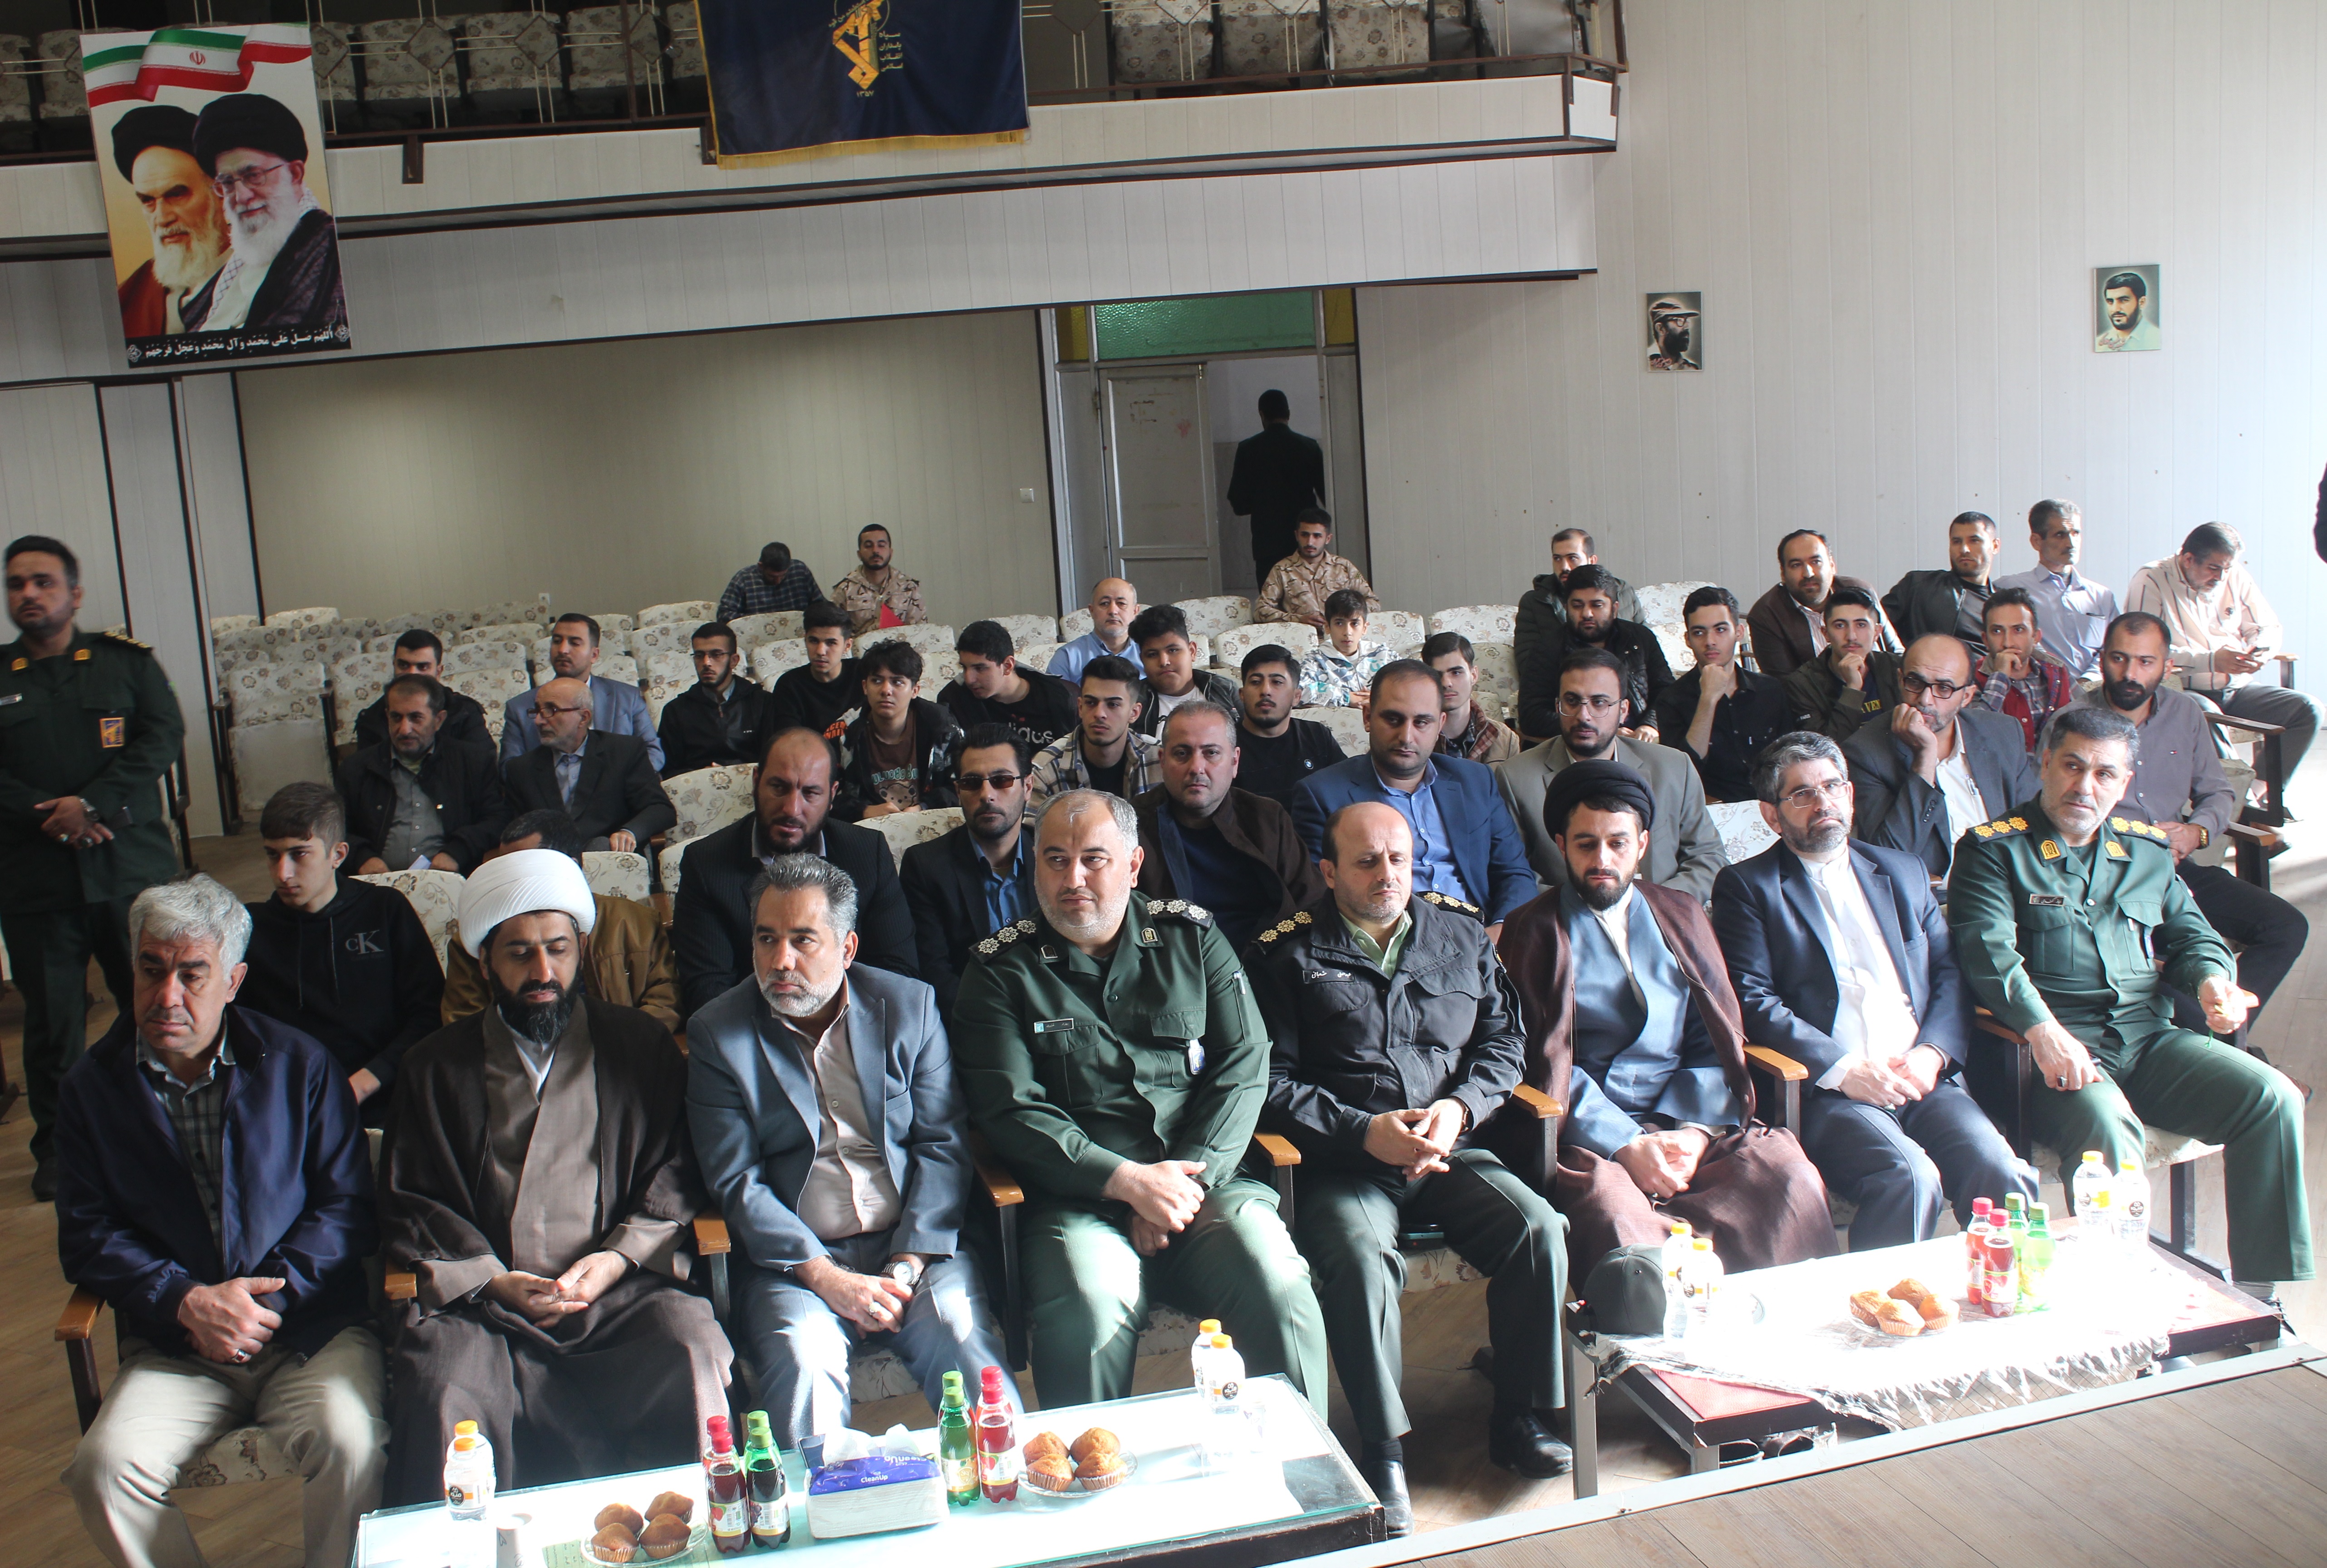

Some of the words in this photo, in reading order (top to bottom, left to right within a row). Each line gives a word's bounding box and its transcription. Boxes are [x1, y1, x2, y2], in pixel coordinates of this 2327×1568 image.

[879, 30, 901, 40] سپاه
[879, 42, 902, 51] پاسداران
[880, 52, 903, 62] انقلاب
[860, 1474, 889, 1483] CleanUp
